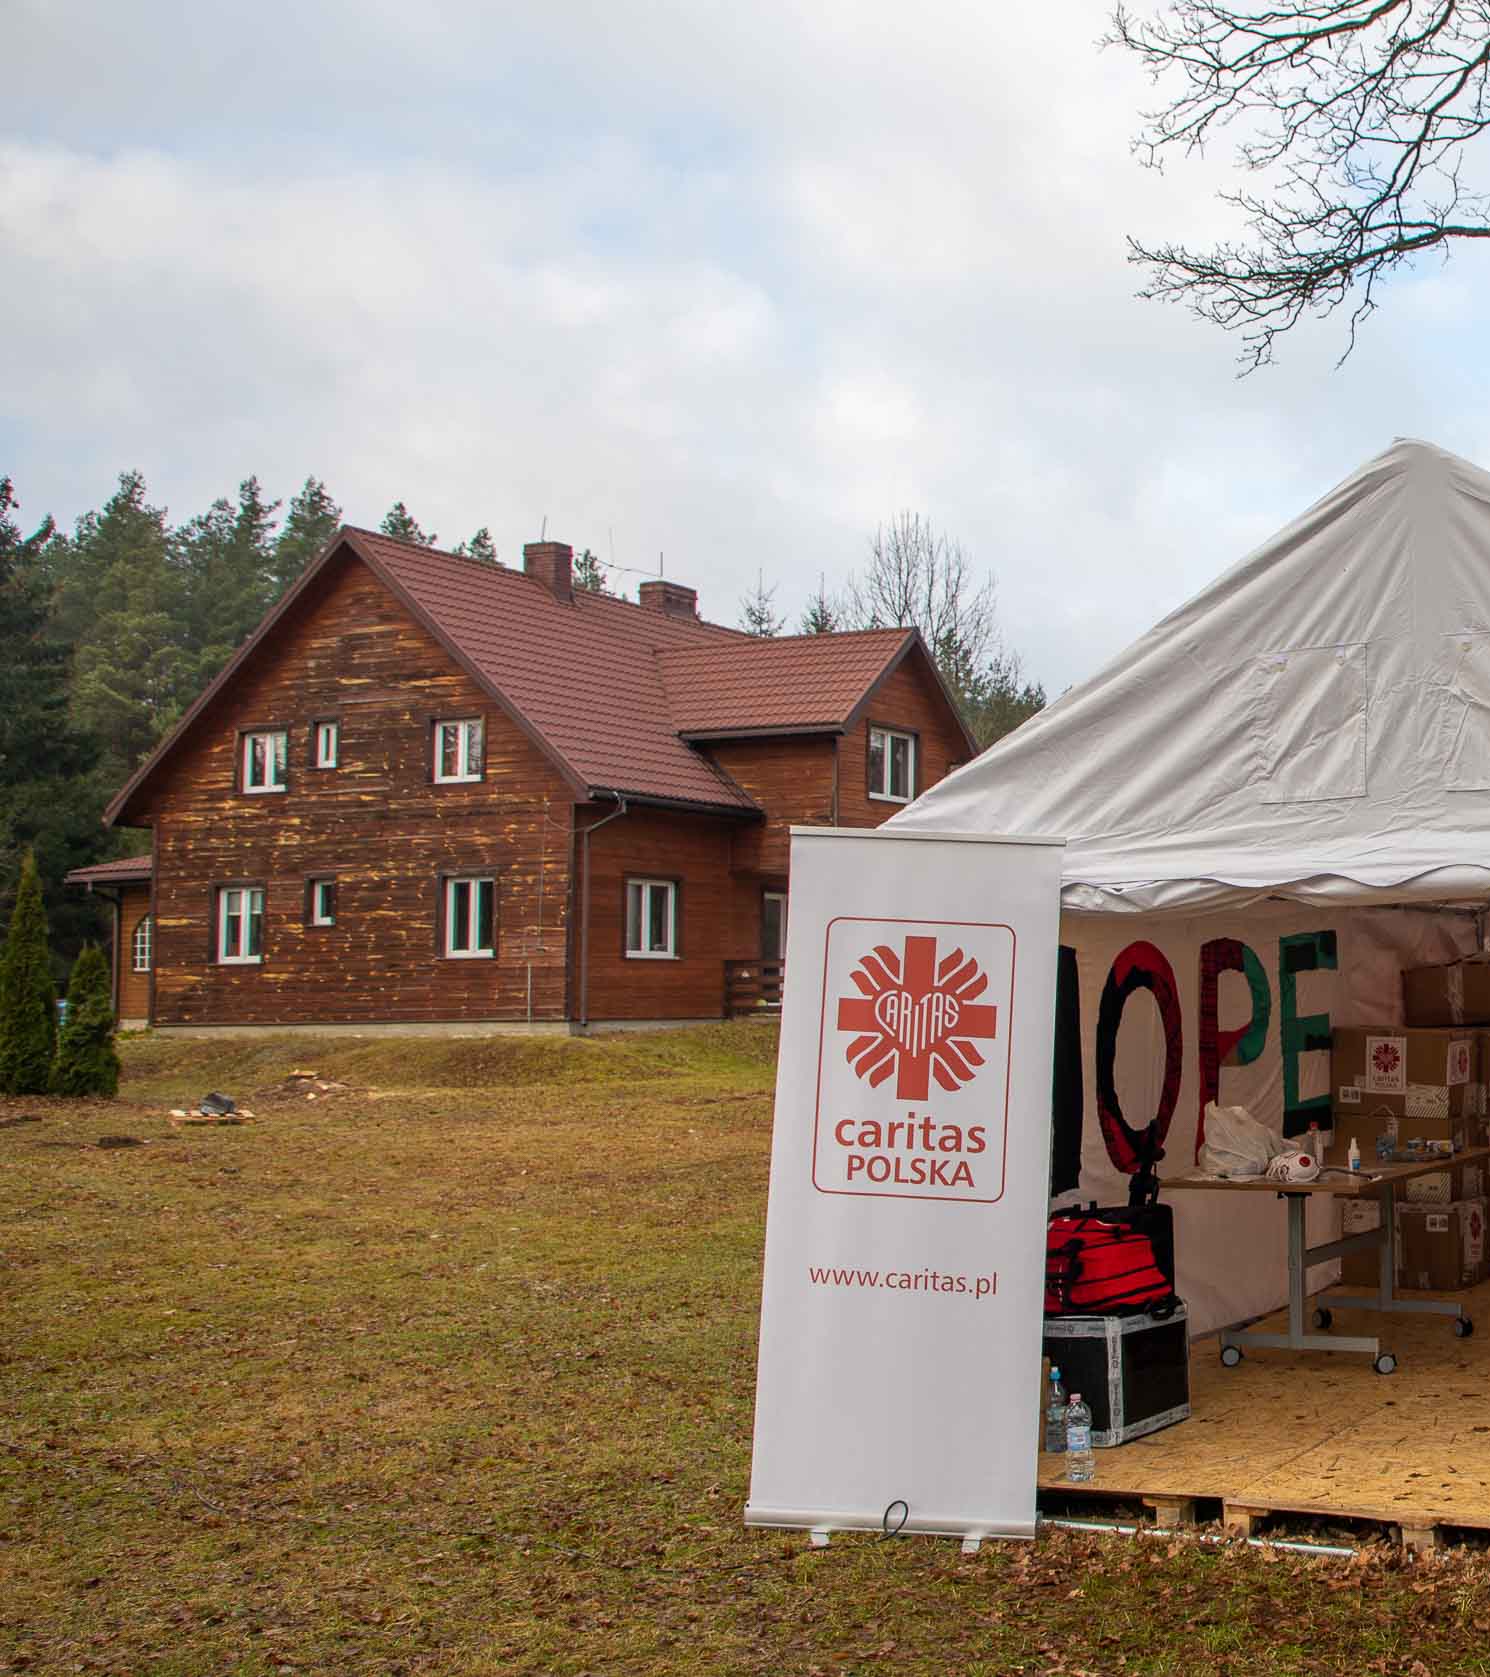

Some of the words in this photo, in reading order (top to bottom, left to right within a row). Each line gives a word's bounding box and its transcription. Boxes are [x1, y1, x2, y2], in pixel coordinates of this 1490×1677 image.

[874, 989, 960, 1058] CARITAS
[834, 1111, 987, 1154] caritas
[846, 1154, 976, 1188] POLSKA
[809, 1265, 998, 1300] www.caritas.pl
